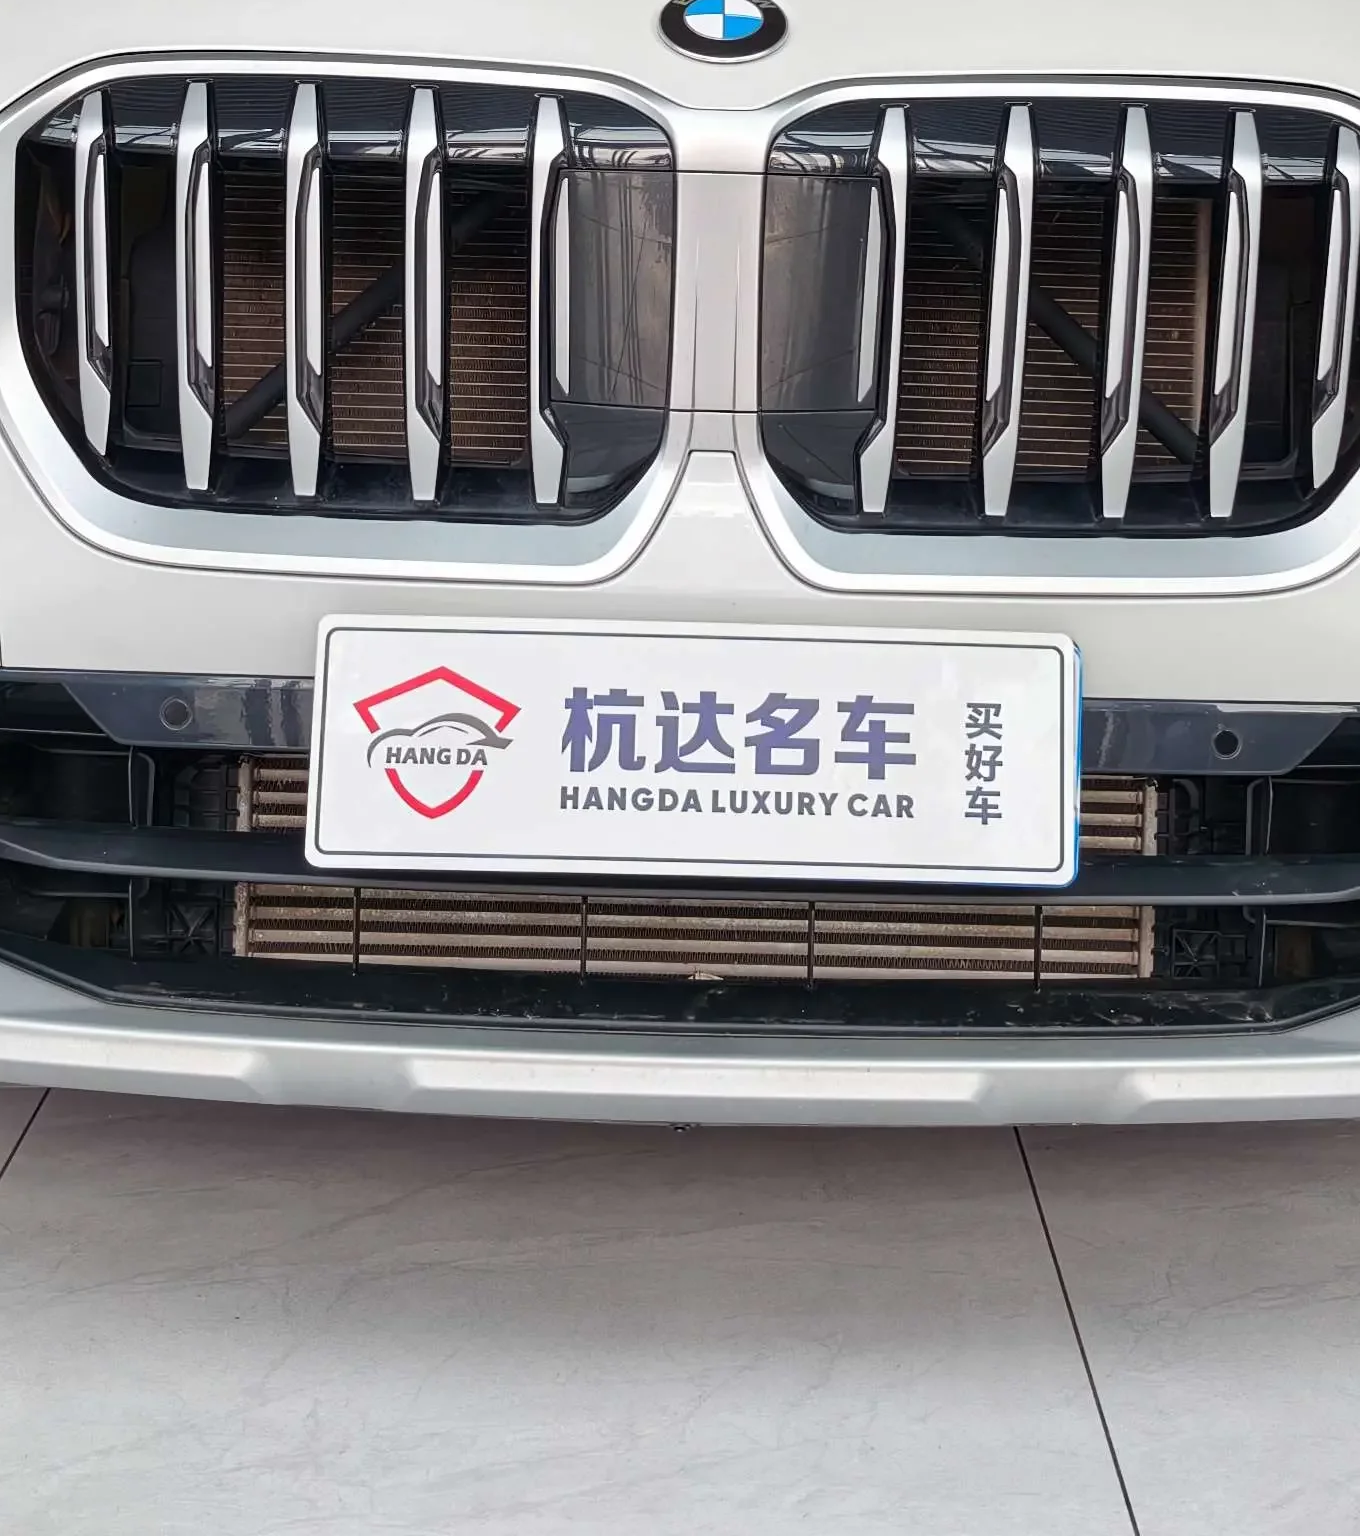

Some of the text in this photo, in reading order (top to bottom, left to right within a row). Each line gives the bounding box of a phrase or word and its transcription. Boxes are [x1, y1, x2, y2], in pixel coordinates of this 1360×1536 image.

[385, 746, 488, 766] HANG DA
[560, 686, 918, 781] 杭达名车
[964, 702, 1003, 826] 买好车
[560, 785, 915, 819] HANGDA LUXURY CAR
